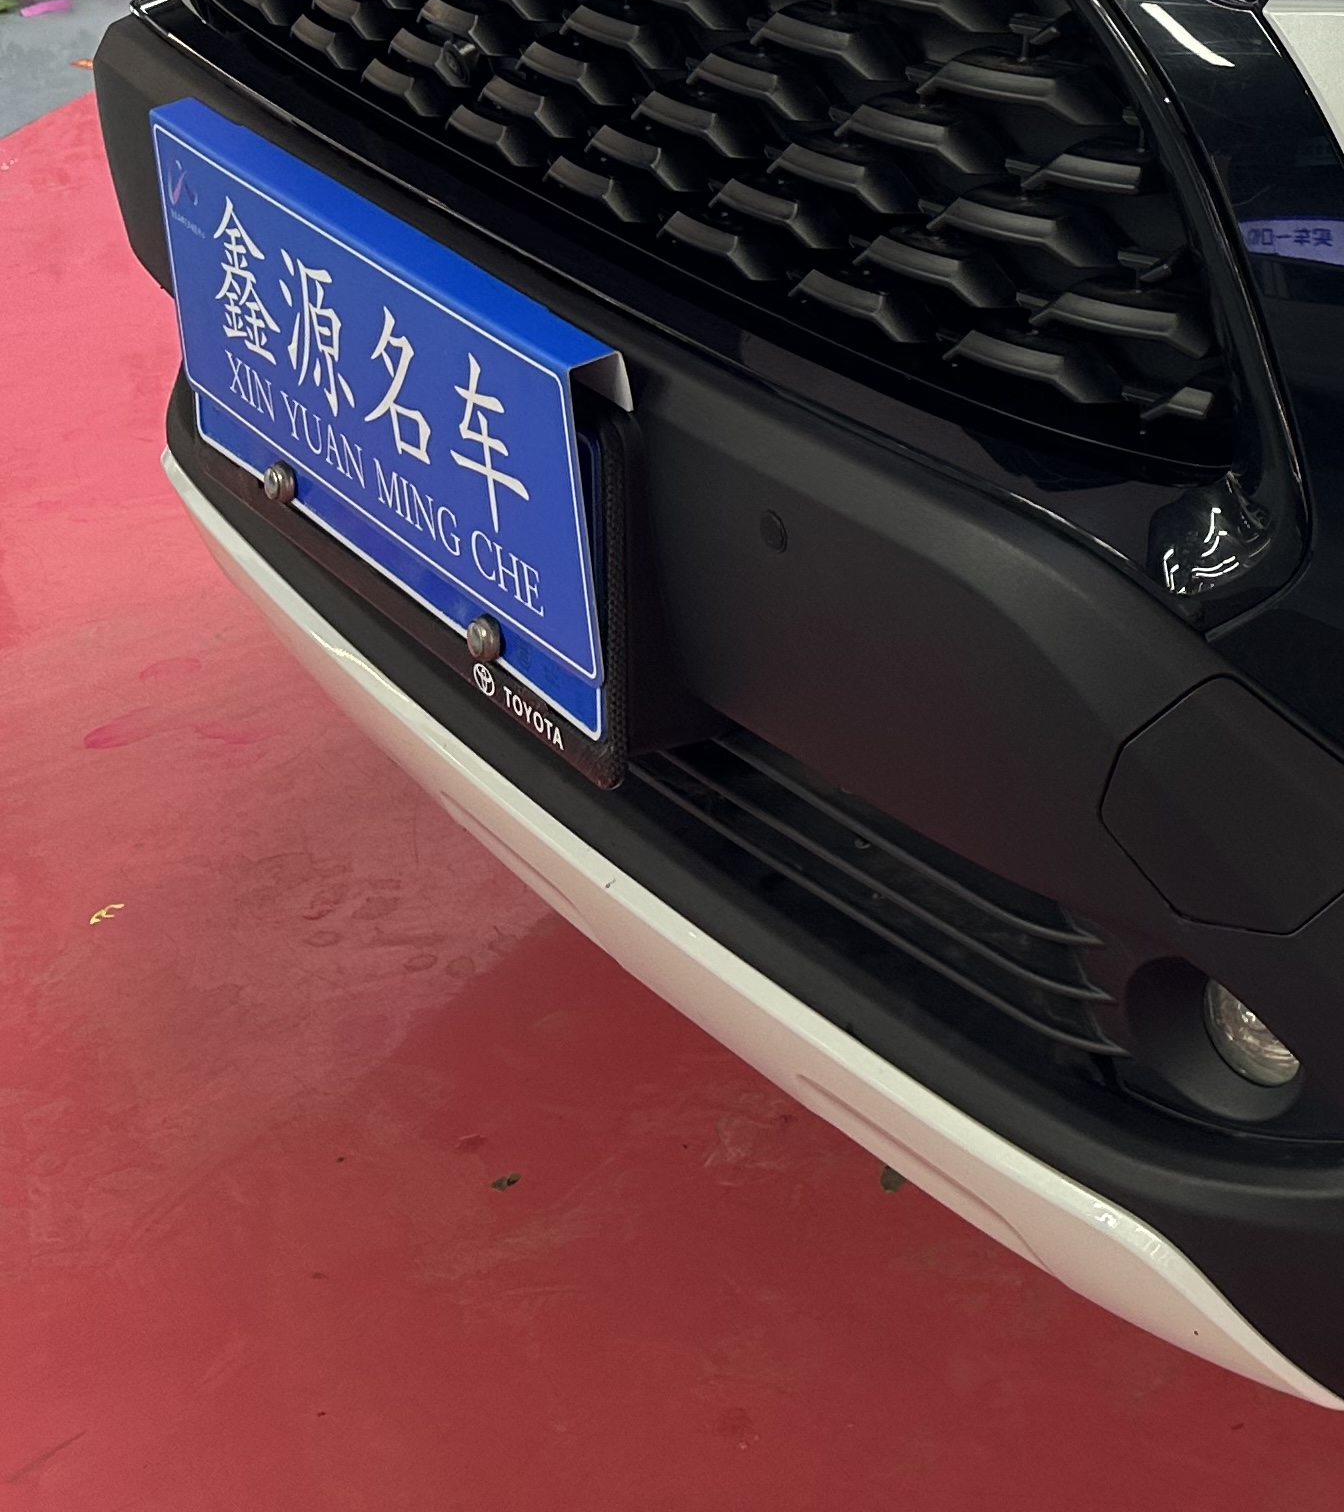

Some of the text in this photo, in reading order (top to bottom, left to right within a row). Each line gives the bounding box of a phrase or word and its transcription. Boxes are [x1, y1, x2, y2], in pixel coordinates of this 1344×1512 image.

[212, 196, 530, 532] 鑫源名车
[224, 350, 546, 617] XIN YUAN MING CHE
[503, 685, 565, 751] TOYOTA
